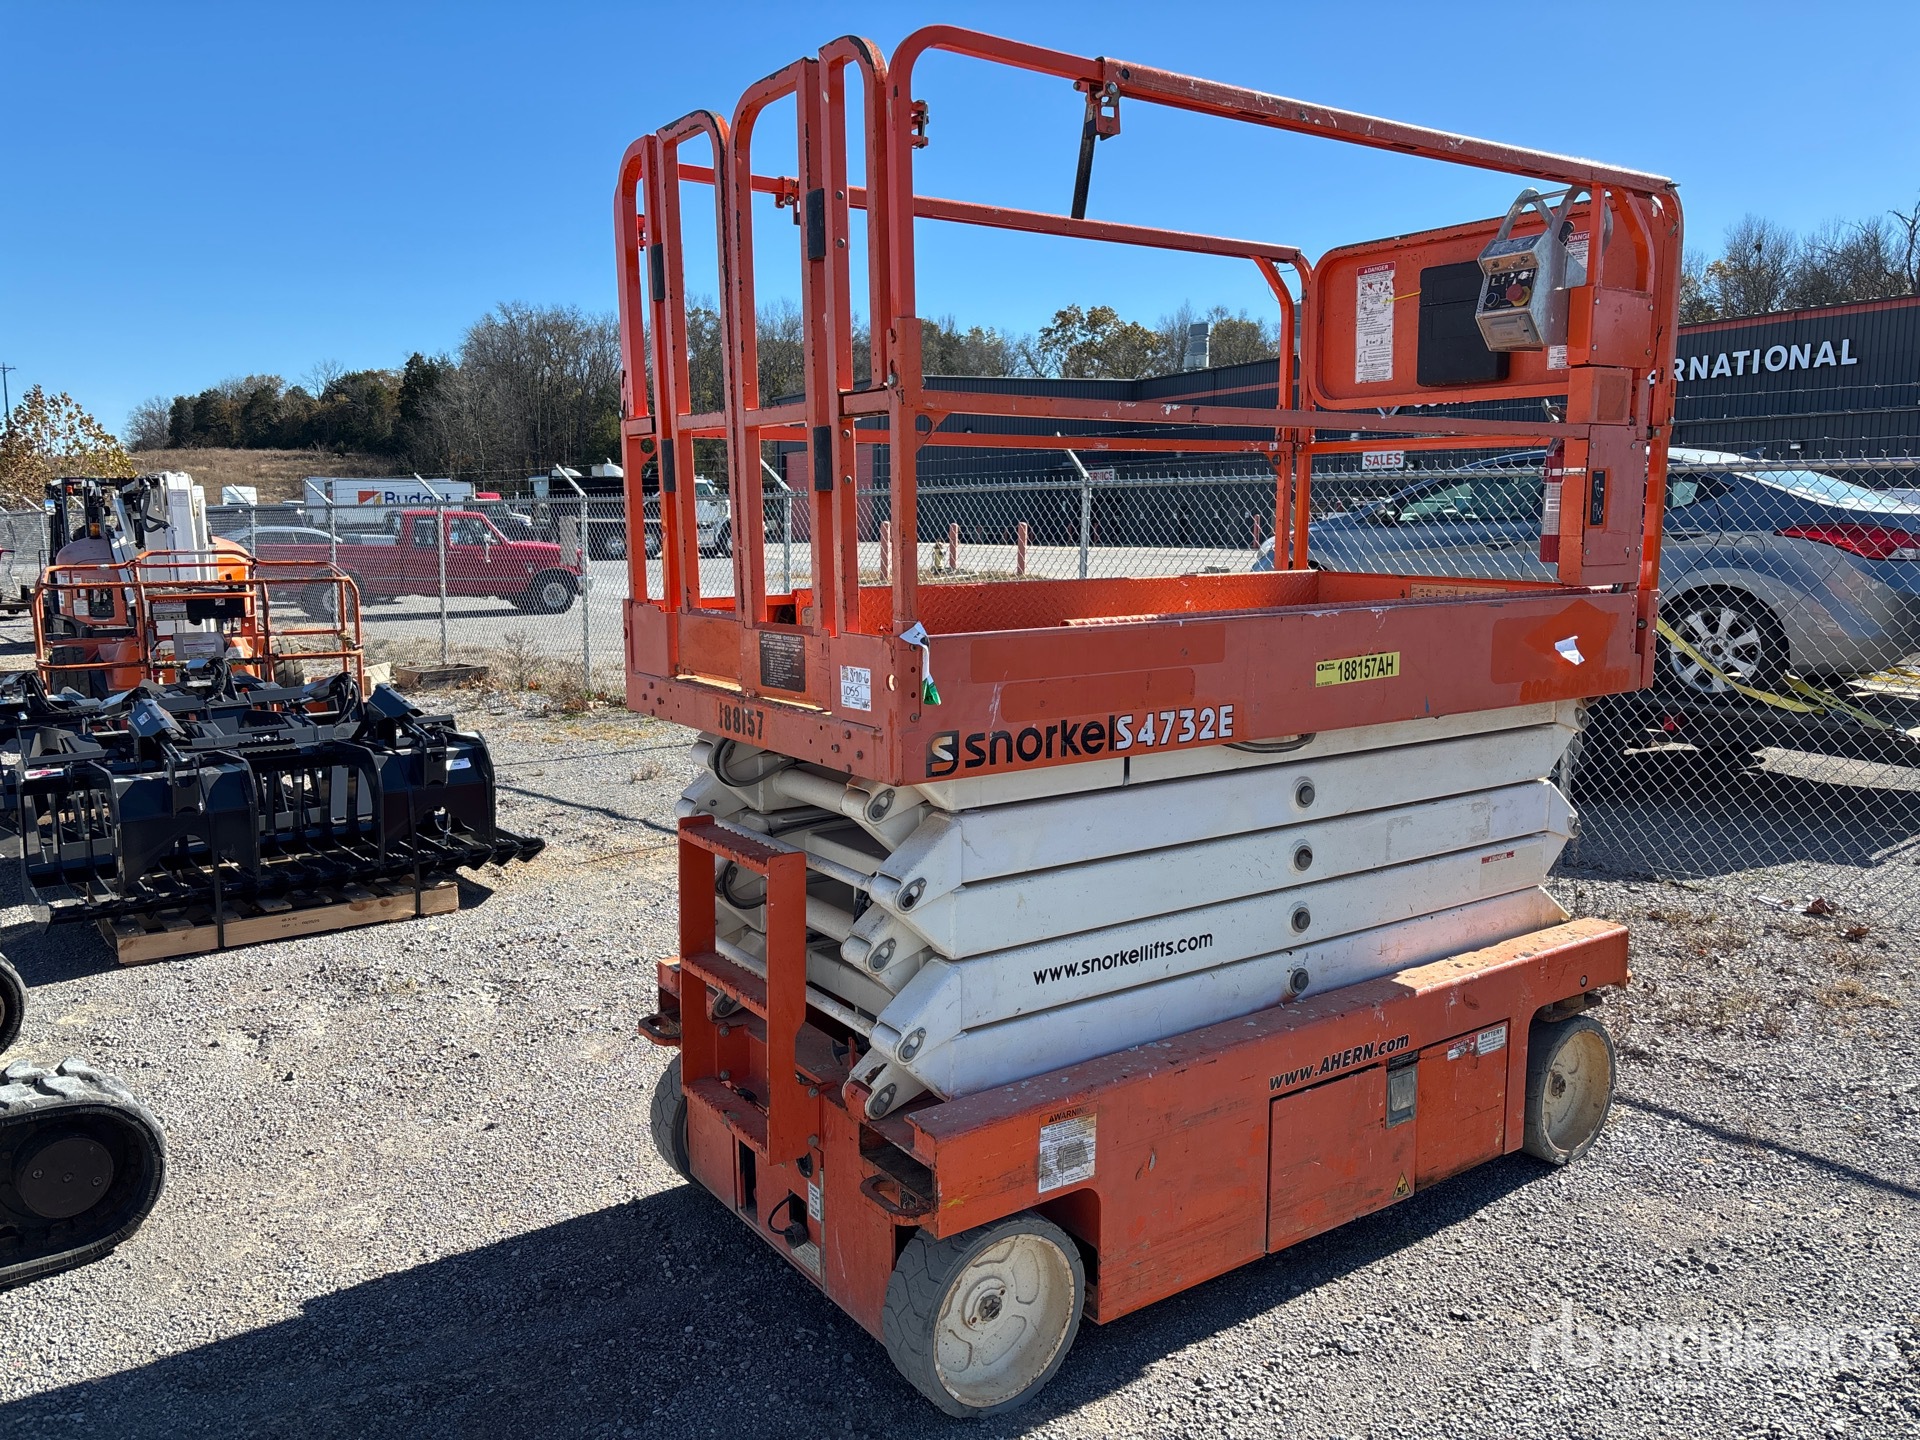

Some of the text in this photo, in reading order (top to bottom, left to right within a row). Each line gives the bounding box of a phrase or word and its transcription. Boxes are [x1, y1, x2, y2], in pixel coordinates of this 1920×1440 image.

[1367, 264, 1389, 273] DANGER
[1364, 452, 1402, 467] SALES
[1089, 470, 1113, 481] ERVICE
[1338, 655, 1394, 681] 188157AH
[843, 685, 860, 697] 1055
[718, 701, 764, 740] 188157
[965, 704, 1235, 768] snorkel S4732E
[1033, 933, 1213, 986] www.snorkellifts.com
[1481, 1028, 1503, 1040] BATTERY
[1269, 1034, 1410, 1091] www.AHERN.com
[1054, 1106, 1090, 1121] WARNING
